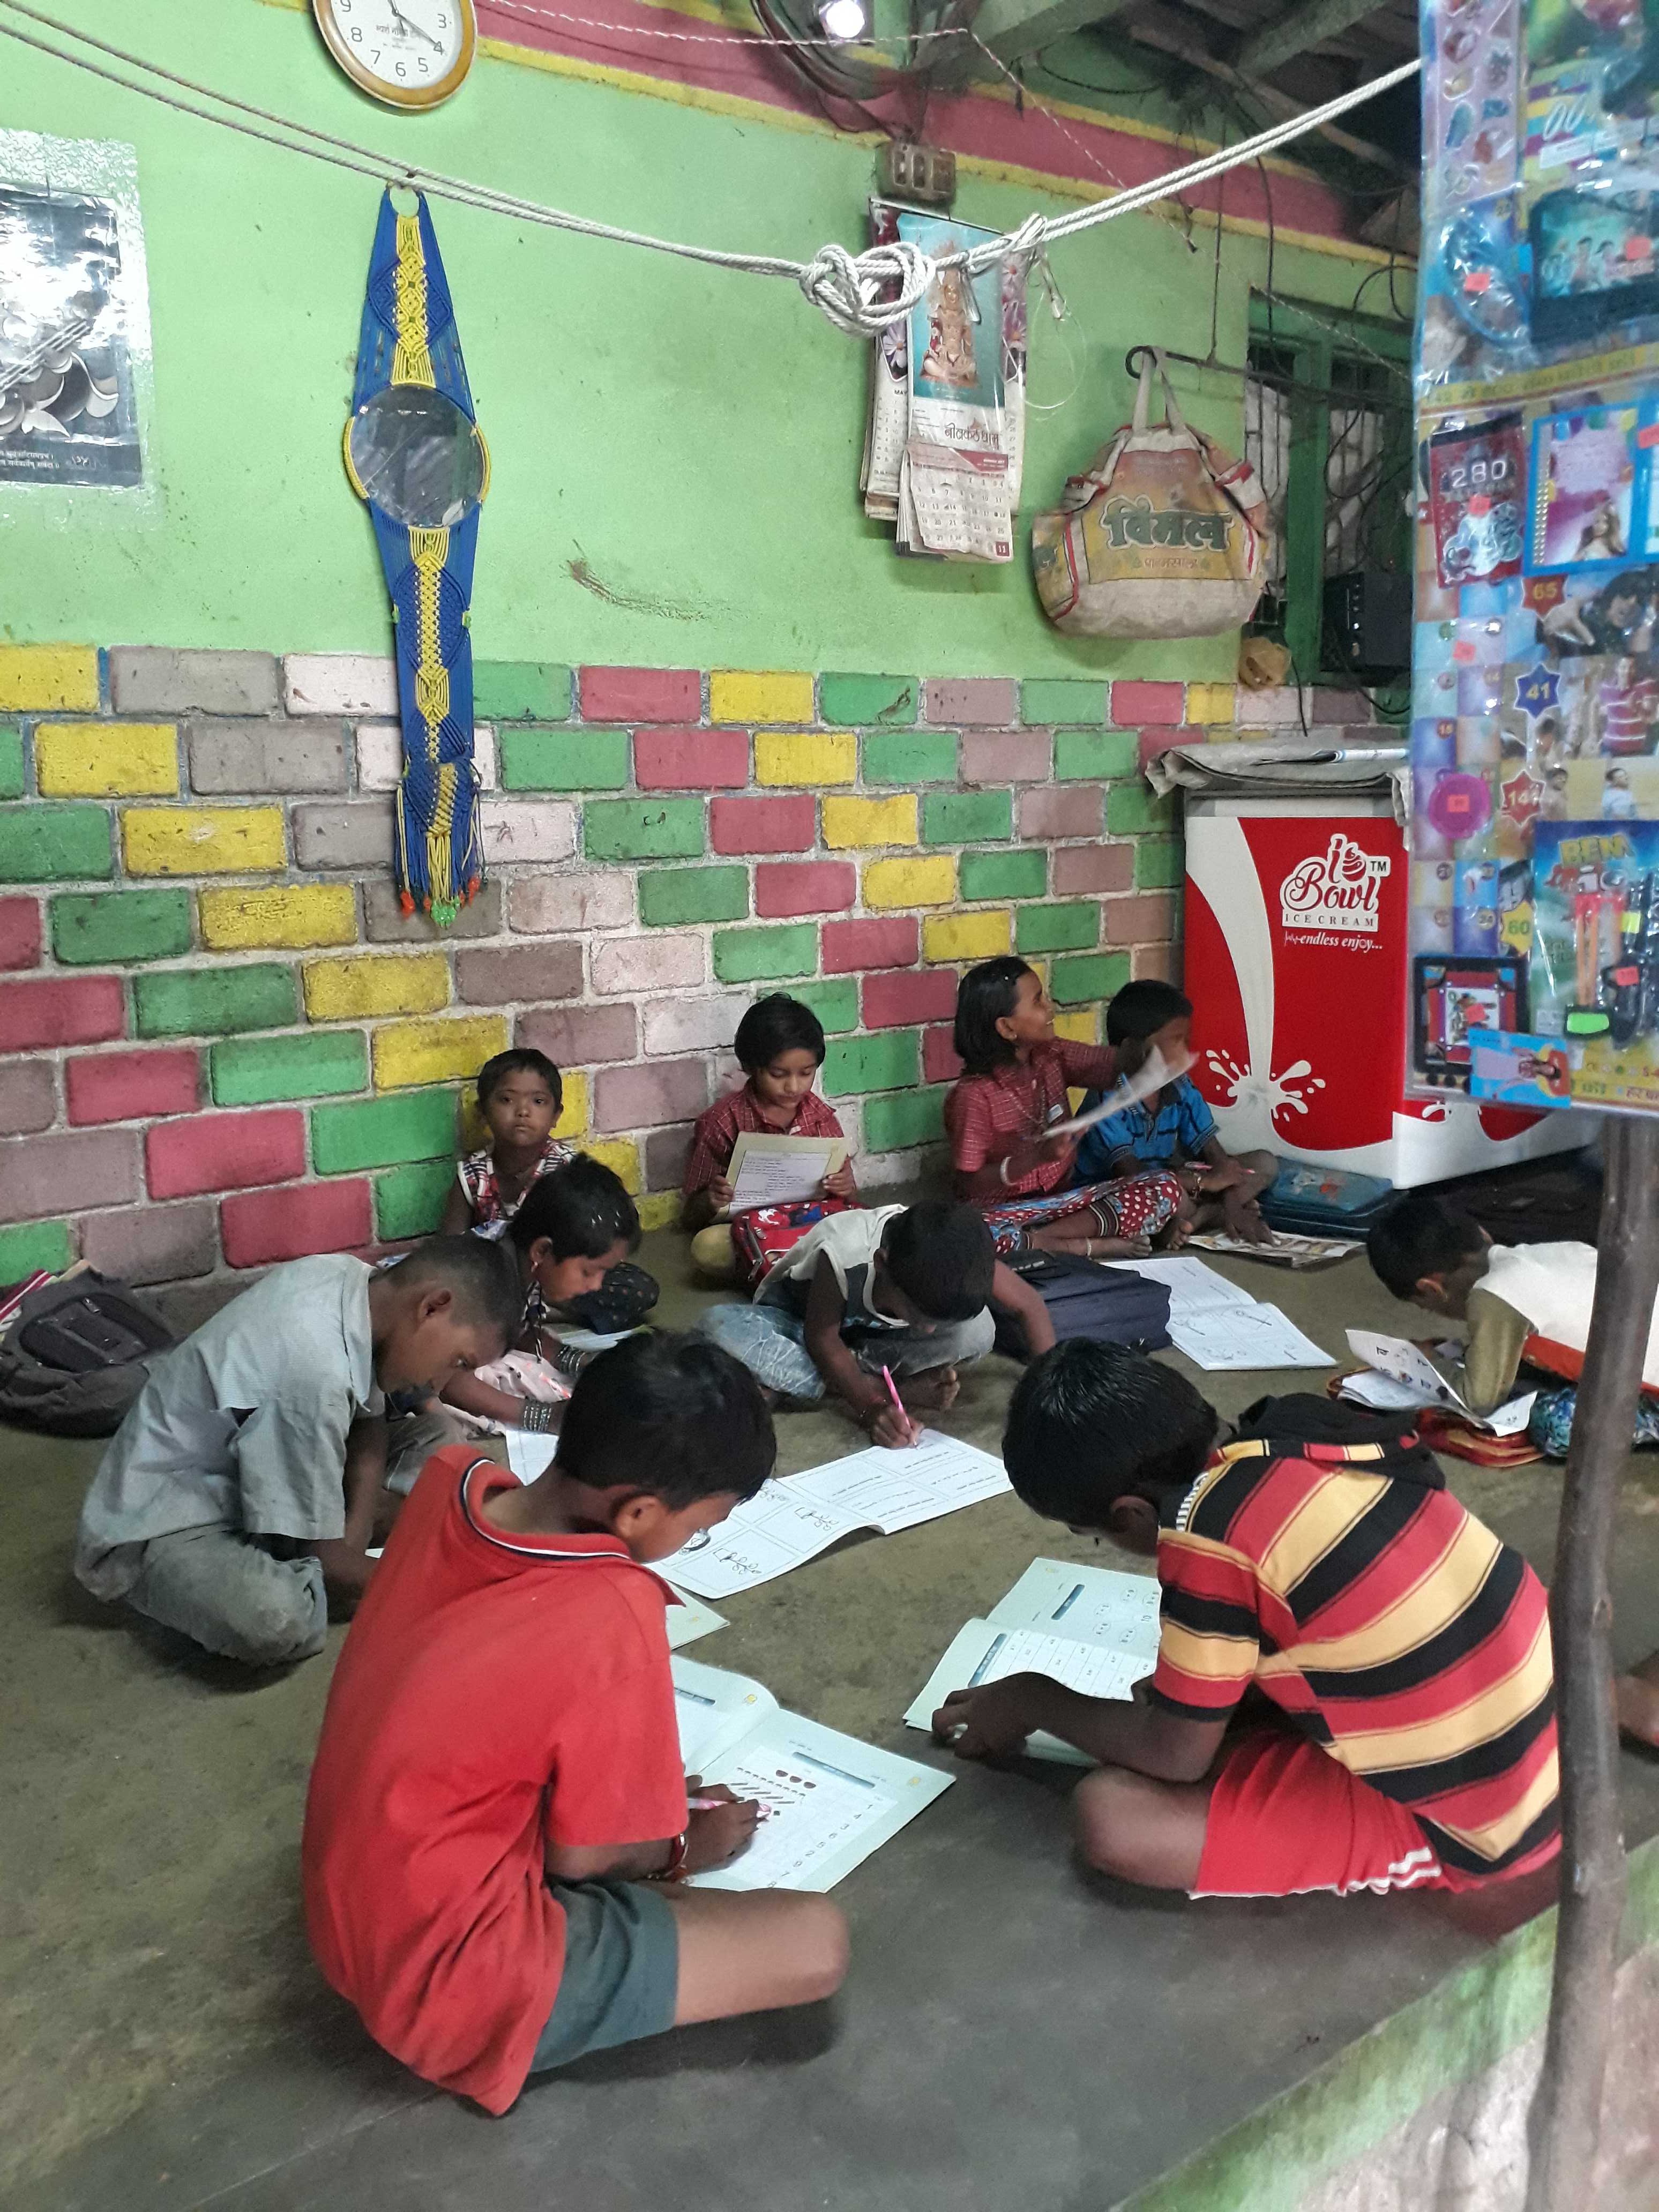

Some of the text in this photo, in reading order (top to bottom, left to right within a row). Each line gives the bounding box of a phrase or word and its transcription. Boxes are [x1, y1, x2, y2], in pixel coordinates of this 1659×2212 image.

[437, 13, 447, 28] 3
[350, 27, 363, 42] 8
[370, 49, 381, 64] 7
[395, 62, 406, 77] 6
[418, 57, 428, 72] 5
[1452, 460, 1506, 487] 280
[1102, 496, 1234, 550] विमल
[1527, 682, 1550, 700] 41
[1370, 861, 1387, 871] TM
[1284, 862, 1377, 911] Bowl
[1286, 913, 1373, 926] ICE CREAM
[1508, 920, 1529, 935] 60
[1299, 931, 1339, 947] endless
